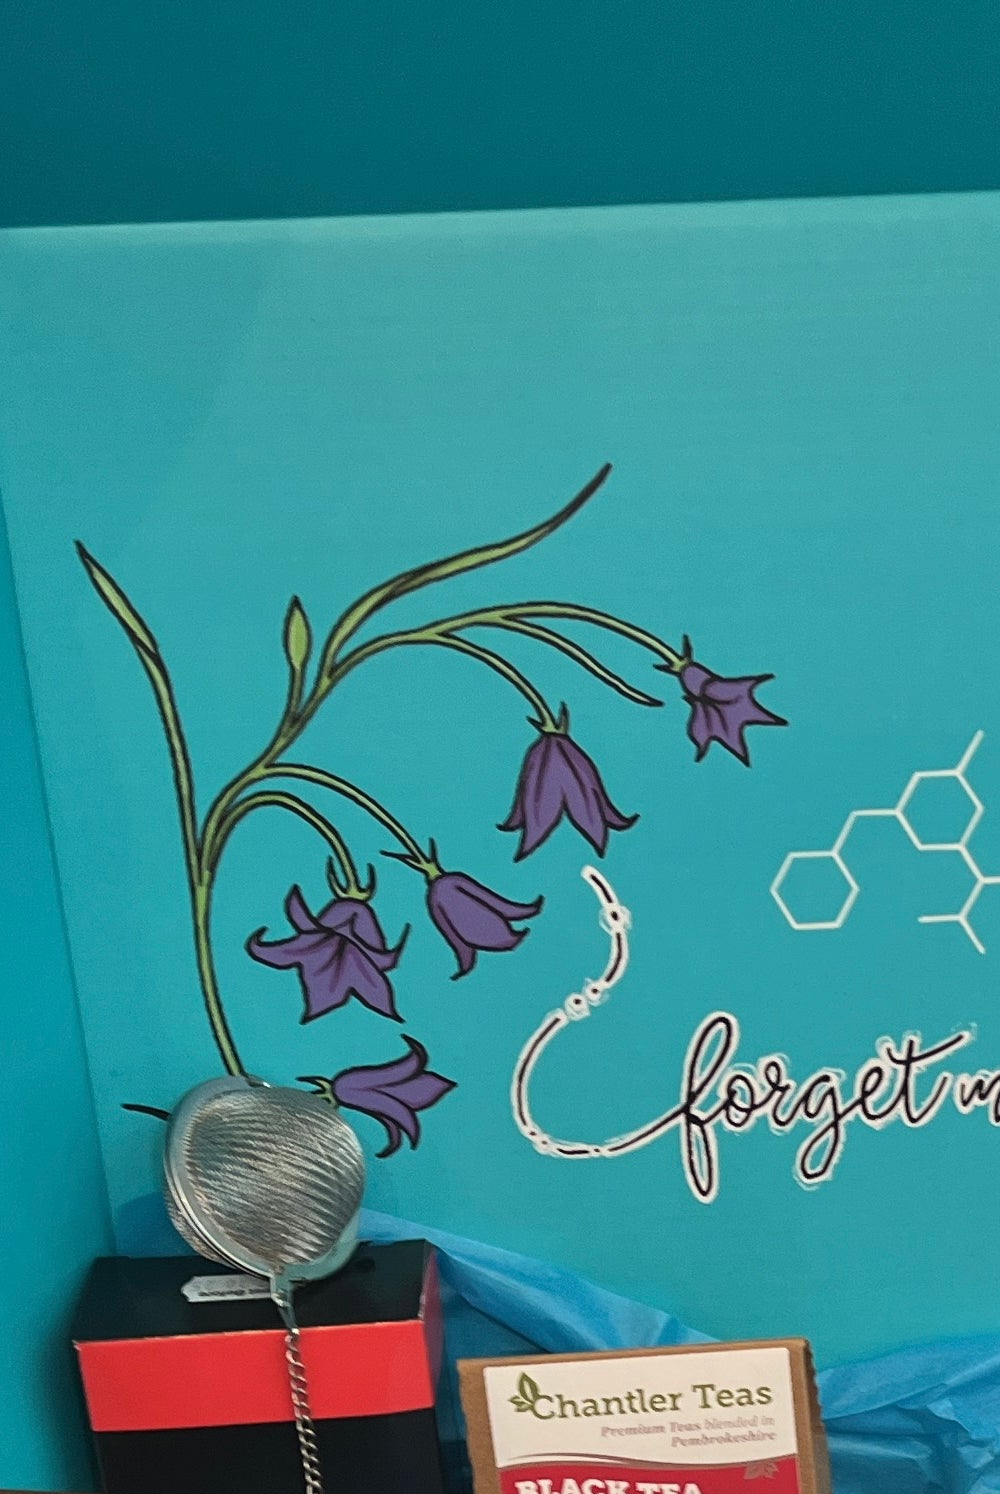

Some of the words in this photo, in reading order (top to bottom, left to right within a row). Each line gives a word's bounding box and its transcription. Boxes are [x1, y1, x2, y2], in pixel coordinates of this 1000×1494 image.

[665, 1010, 978, 1206] forget
[528, 1390, 684, 1421] Chantler
[692, 1383, 773, 1411] Teas
[601, 1424, 665, 1437] Premium
[669, 1421, 701, 1433] Teas
[704, 1416, 757, 1430] blended
[761, 1416, 774, 1426] in
[671, 1431, 777, 1447] Pembrokeshire
